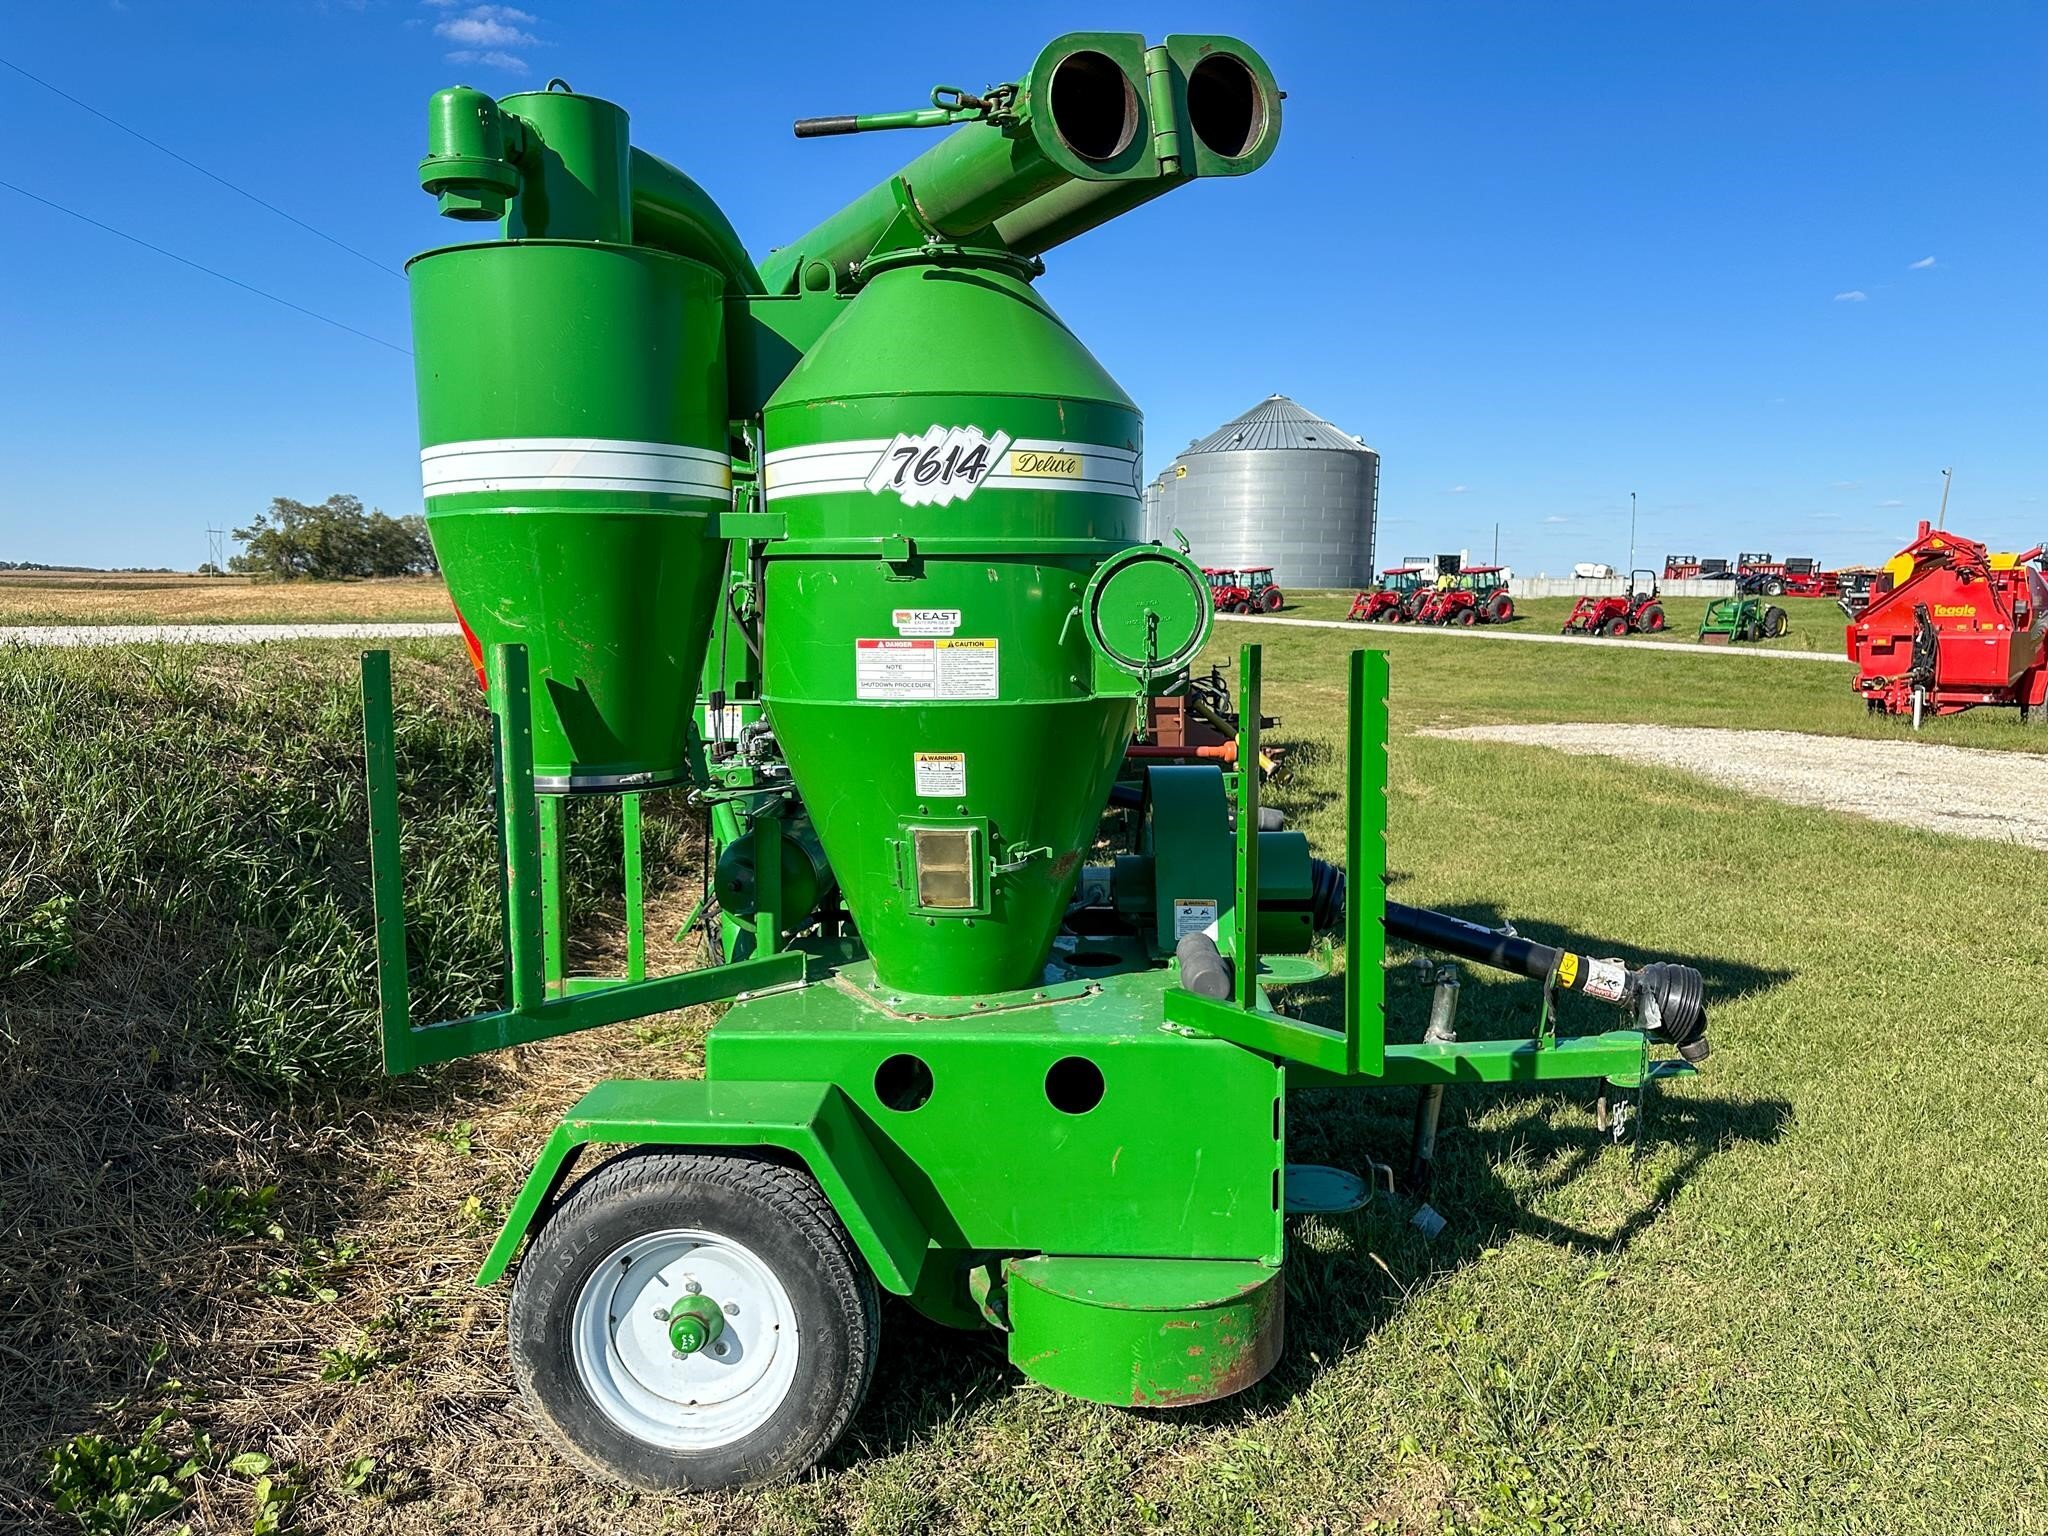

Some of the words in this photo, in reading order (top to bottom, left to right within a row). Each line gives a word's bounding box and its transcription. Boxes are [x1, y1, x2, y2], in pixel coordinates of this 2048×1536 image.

[892, 443, 988, 486] 7614
[1014, 453, 1077, 475] Deluxe
[914, 612, 958, 621] KEAST
[1934, 604, 1977, 617] Teagle
[531, 1223, 601, 1343] CARLISLE
[740, 1424, 810, 1480] TRAIL
